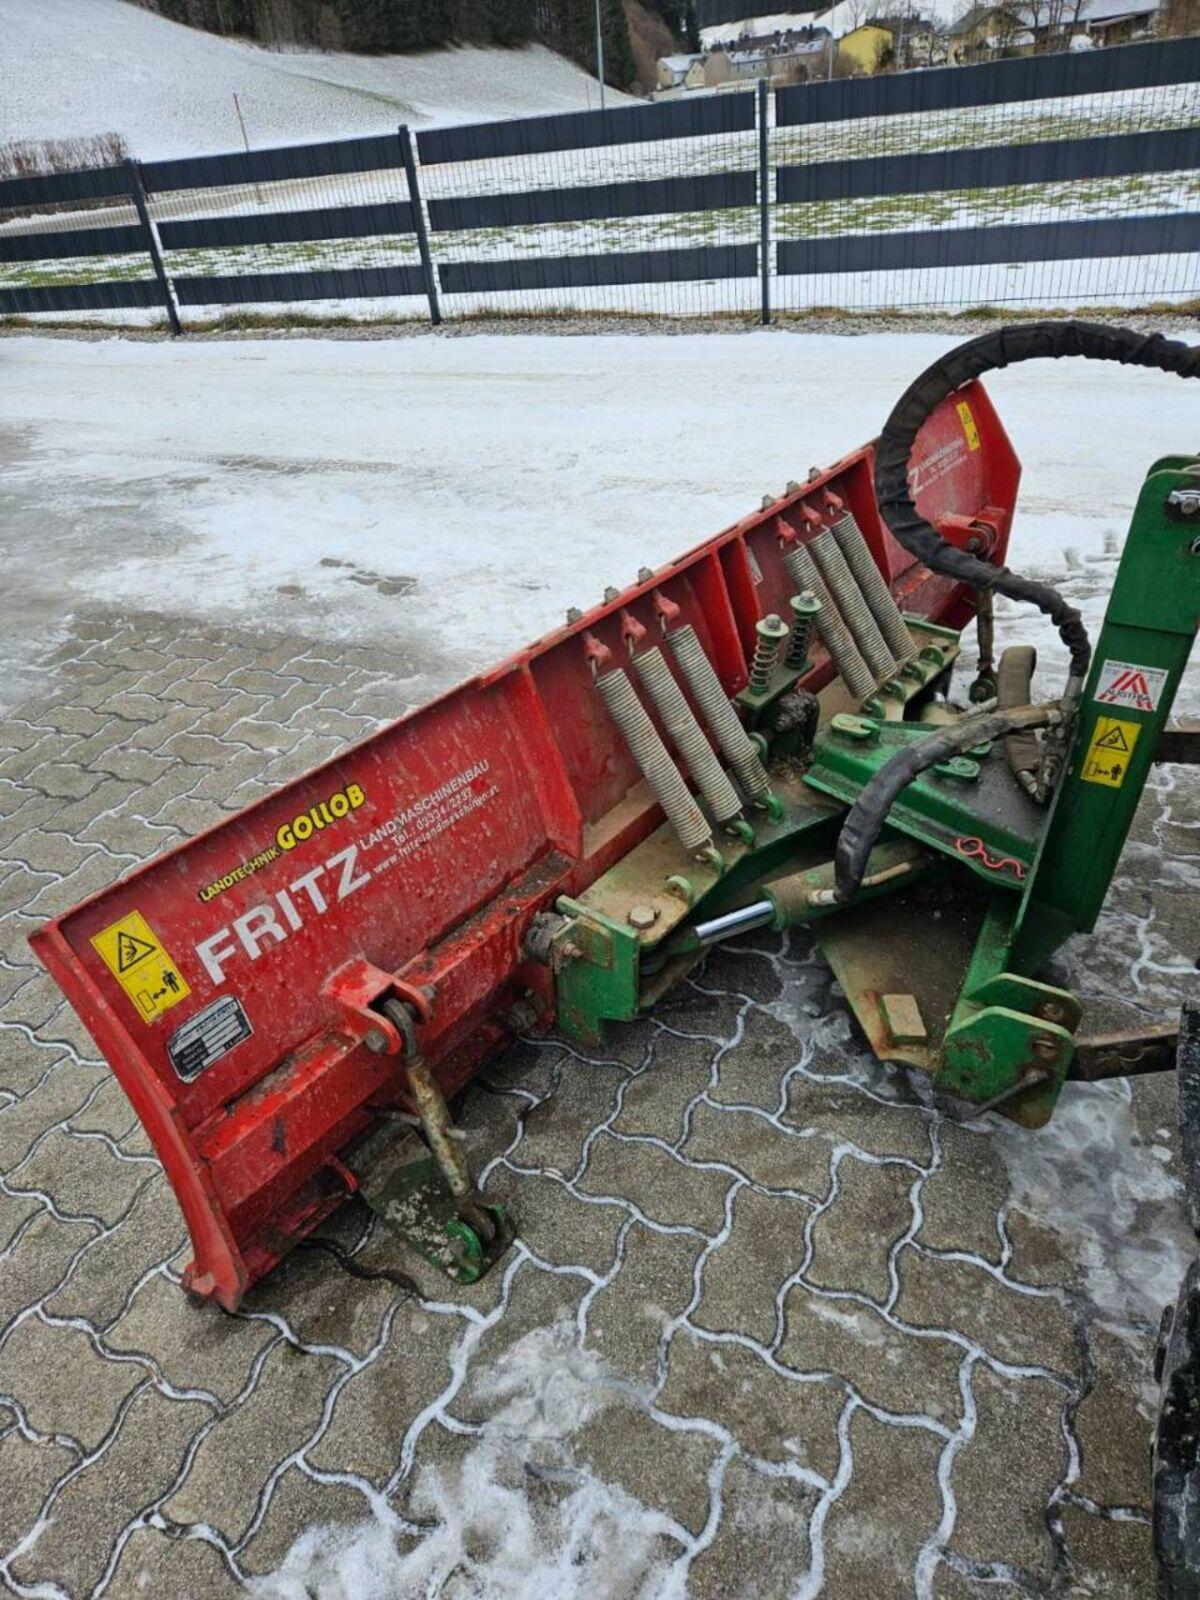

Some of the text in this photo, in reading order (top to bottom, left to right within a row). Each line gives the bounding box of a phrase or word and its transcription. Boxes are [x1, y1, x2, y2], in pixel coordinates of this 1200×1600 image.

[359, 759, 489, 850] LANDMASCHINENBAU
[194, 844, 373, 986] FRITZ
[199, 847, 280, 902] LANDTECHNIK
